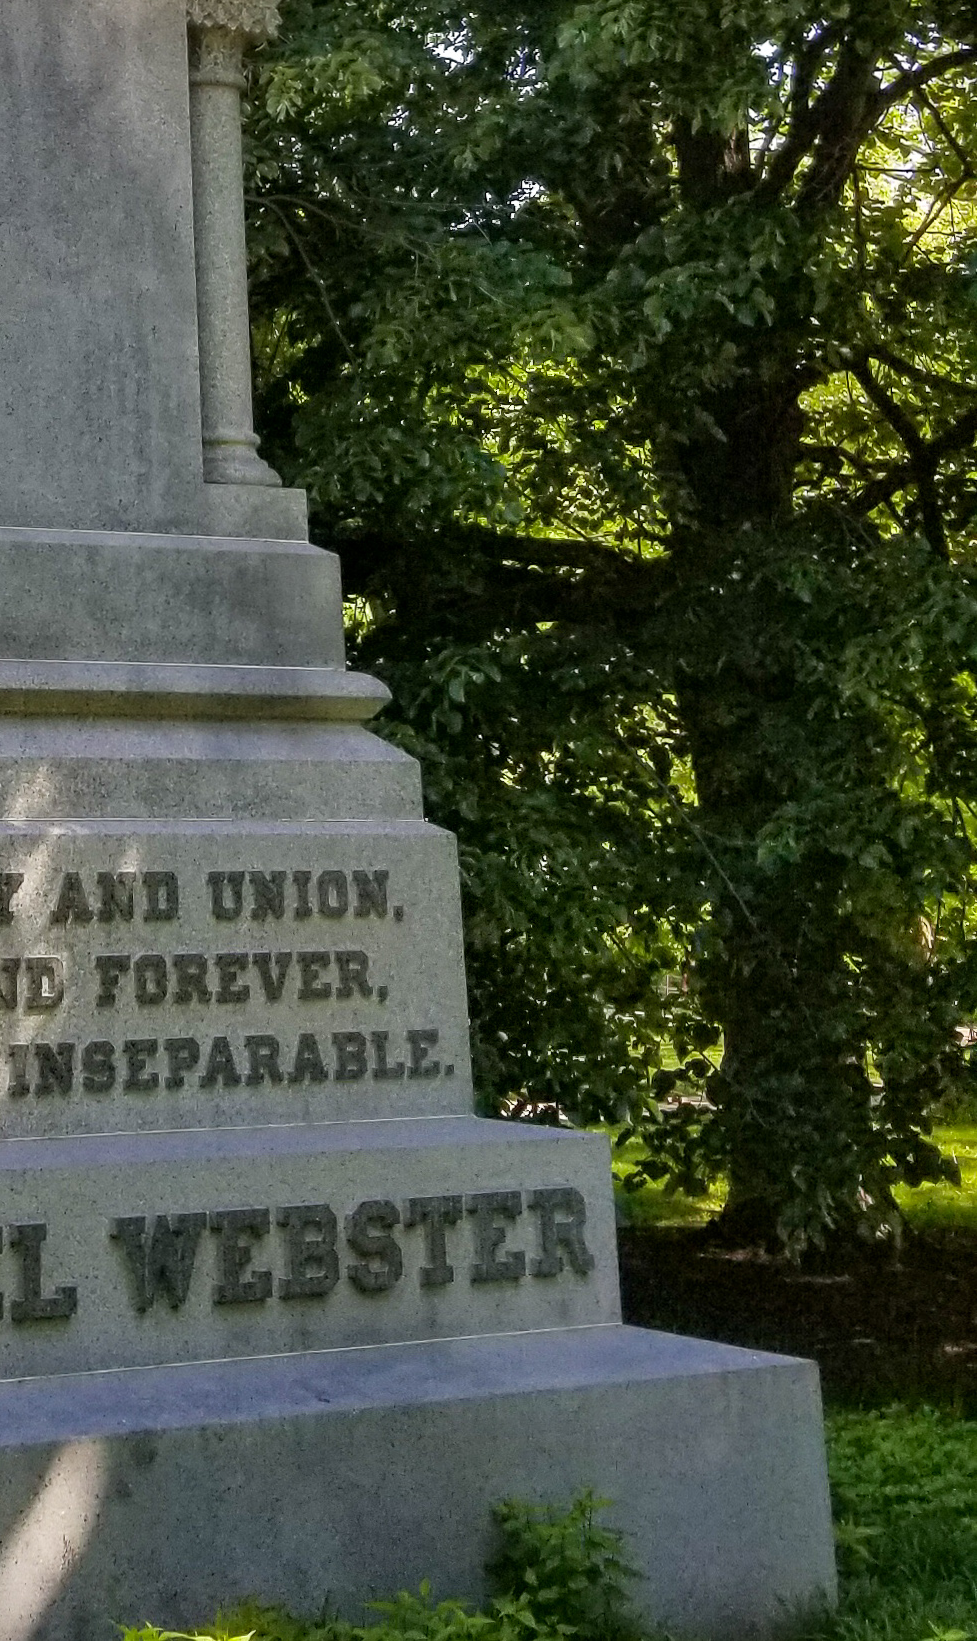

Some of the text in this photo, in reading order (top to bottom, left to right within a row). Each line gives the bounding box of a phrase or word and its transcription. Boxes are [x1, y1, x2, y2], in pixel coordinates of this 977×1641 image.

[52, 869, 180, 924] AND
[208, 869, 404, 923] UNION,
[94, 950, 389, 1009] FOREVER,
[7, 1028, 455, 1098] INSEPARABLE.
[109, 1186, 595, 1313] WEBSTER
